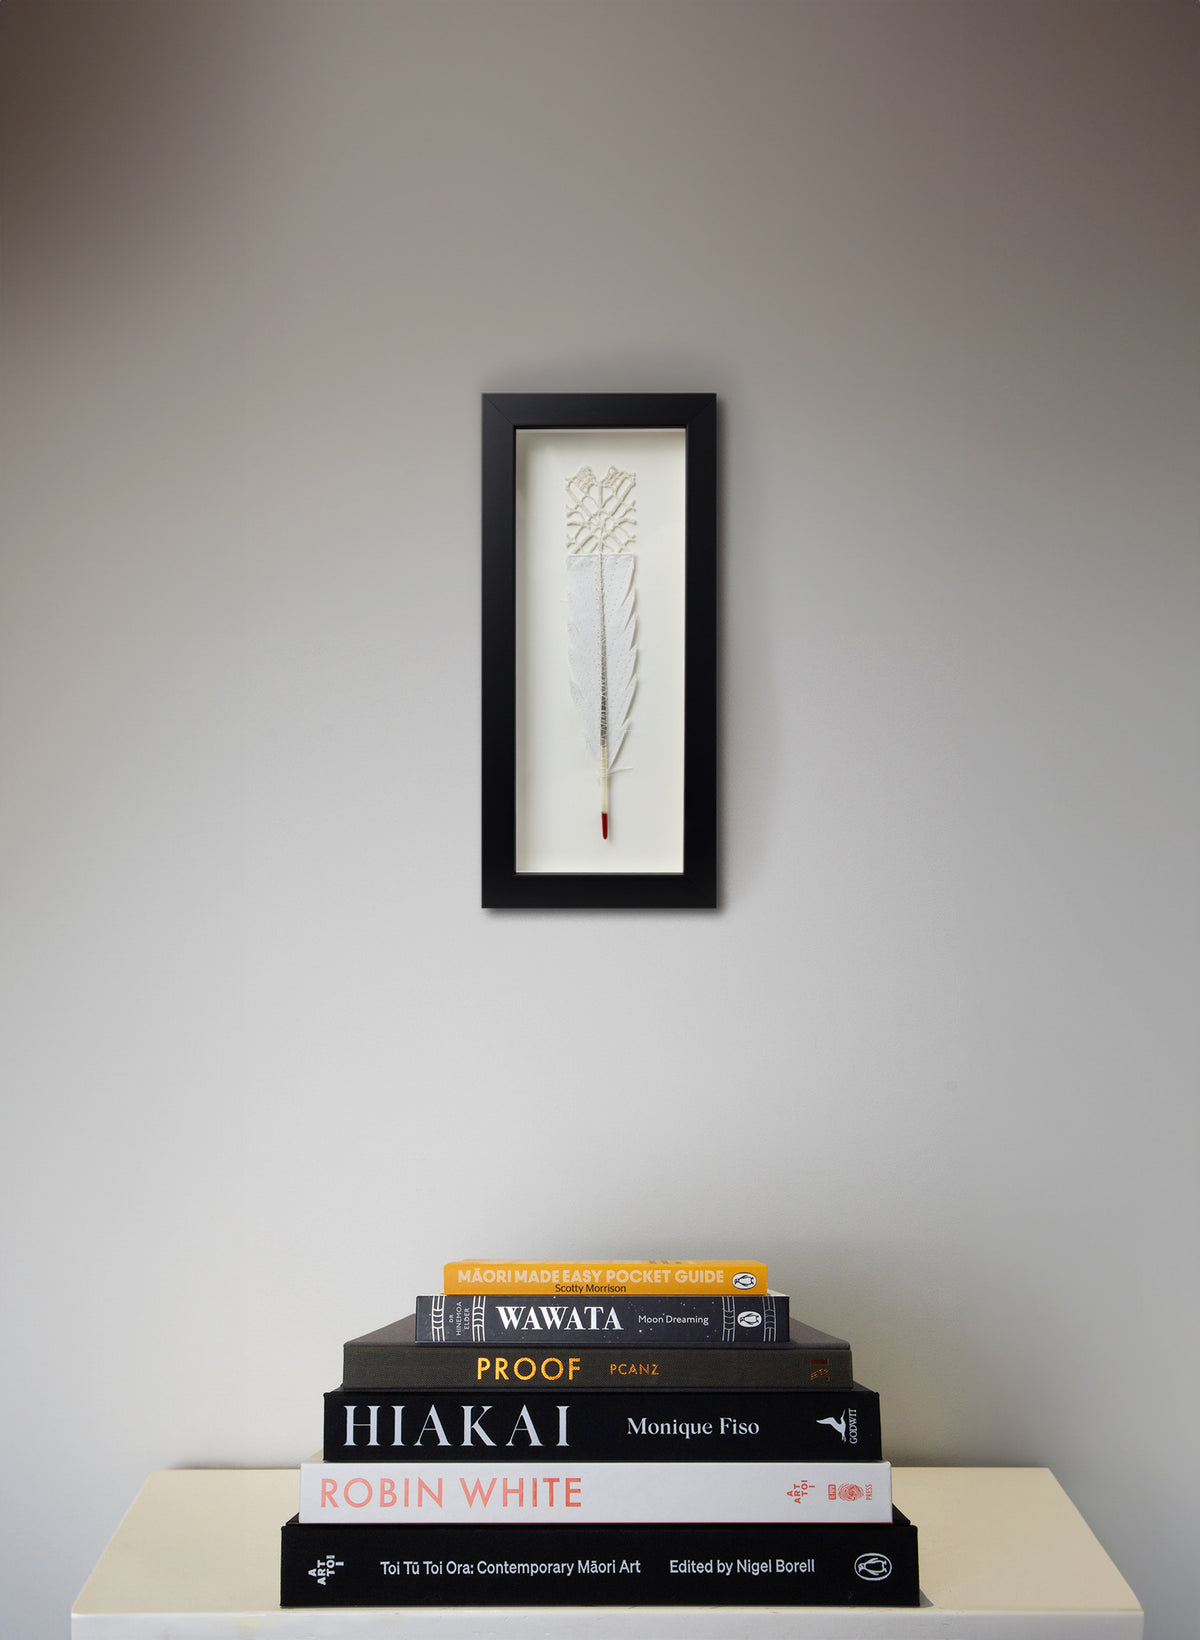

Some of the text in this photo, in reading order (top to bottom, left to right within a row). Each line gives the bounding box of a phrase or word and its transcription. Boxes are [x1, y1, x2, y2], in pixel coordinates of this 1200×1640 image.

[458, 1268, 725, 1283] MĀORI MADE EASY POCKET GUIDE
[555, 1284, 626, 1294] Scotty Morrison
[496, 1306, 623, 1330] WAWATA
[637, 1315, 709, 1326] Moon Dreaming
[477, 1357, 580, 1380] PROOF
[610, 1363, 659, 1375] PCANZ
[343, 1404, 571, 1446] HIAKAI
[627, 1418, 759, 1439] Monique Fiso
[848, 1408, 858, 1444] GODWIT
[321, 1477, 582, 1508] ROBIN WHITE
[793, 1484, 801, 1504] ART
[317, 1559, 326, 1586] ART
[380, 1560, 641, 1576] Toi Tū Toi Ora: Contemporary Māori Art
[670, 1559, 815, 1576] Edited by Nigel Borell
